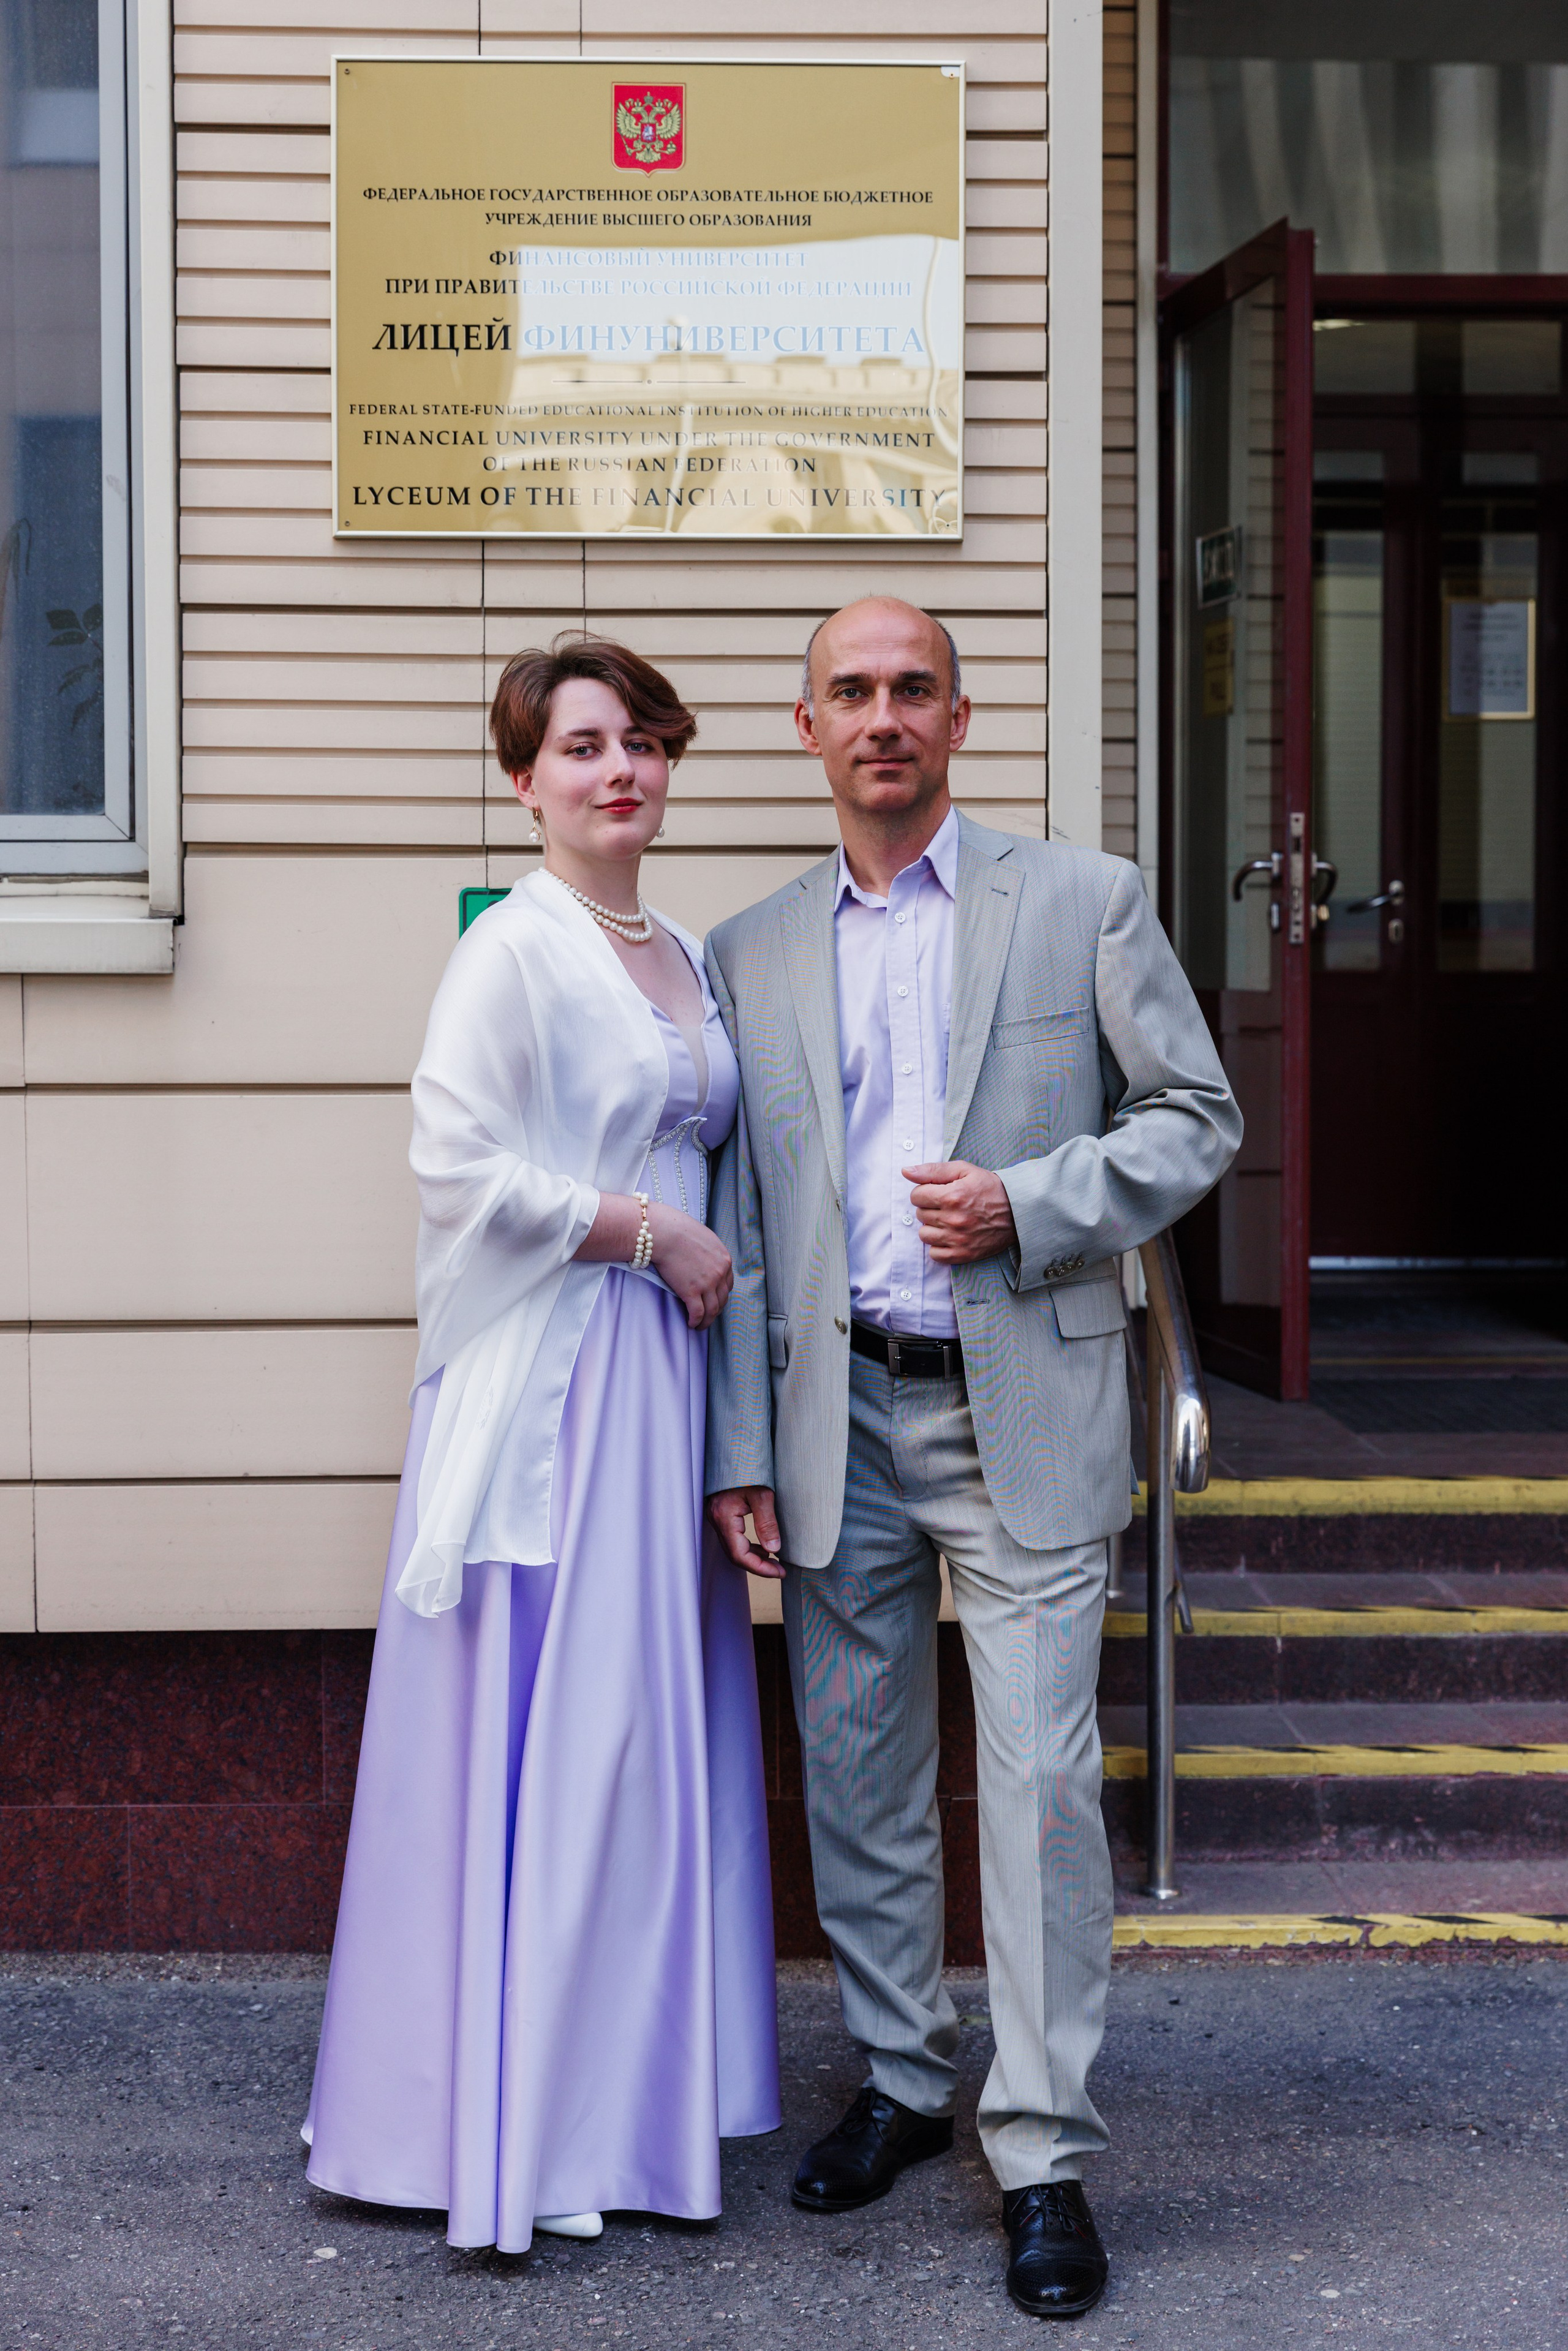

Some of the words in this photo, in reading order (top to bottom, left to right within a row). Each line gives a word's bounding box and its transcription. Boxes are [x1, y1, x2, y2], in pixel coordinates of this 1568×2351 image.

[363, 187, 485, 203] ФЕДЕРАЛЬНОЕ
[489, 189, 652, 203] ГОСУДАРСТВЕННОЕ
[657, 189, 819, 202] ОБРАЗОВАТЕЛЬНОЕ
[823, 191, 933, 205] БЮДЖЕТНОЕ
[485, 213, 598, 227] УЧРЕЖДЕНИЕ
[602, 213, 685, 226] ВЫСШЕГО
[689, 214, 812, 226] ОБРАЗОВАНИЯ
[489, 247, 650, 266] ФИНАНСОВЫЙ
[657, 252, 808, 266] УНИВЕРСИТЕТ
[385, 278, 429, 294] ПРИ
[435, 278, 614, 295] ПРАВИТЕЛЬСТВЕ
[620, 276, 771, 296] РОССИЙСКОЙ
[777, 280, 911, 298] ФЕДЕРАЦИИ
[372, 317, 512, 357] ЛИЦЕЙ
[523, 324, 925, 353] ФИНУНИВЕРСИТЕТА
[349, 404, 418, 415] FEDERAL
[422, 404, 538, 415] STATE-FUNDED
[543, 405, 655, 417] EDUCATIONAL
[768, 406, 788, 417] OF
[792, 406, 851, 417] HIGHER
[858, 406, 948, 418] EDUCATION
[363, 430, 489, 445] FINANCIAL
[495, 431, 634, 446] UNIVERSITY
[640, 432, 717, 447] UNDER
[724, 432, 767, 447] THE
[775, 432, 935, 448] GOVERNMENT
[483, 456, 510, 471] OF
[518, 457, 560, 471] THE
[567, 457, 666, 472] RUSSIAN
[673, 458, 816, 472] FEDERATION
[353, 486, 471, 505] LYCEUM
[480, 486, 516, 506] OF
[526, 487, 582, 506] THE
[592, 488, 756, 507] FINANCIAL
[766, 488, 946, 507] UNIVERSITY
